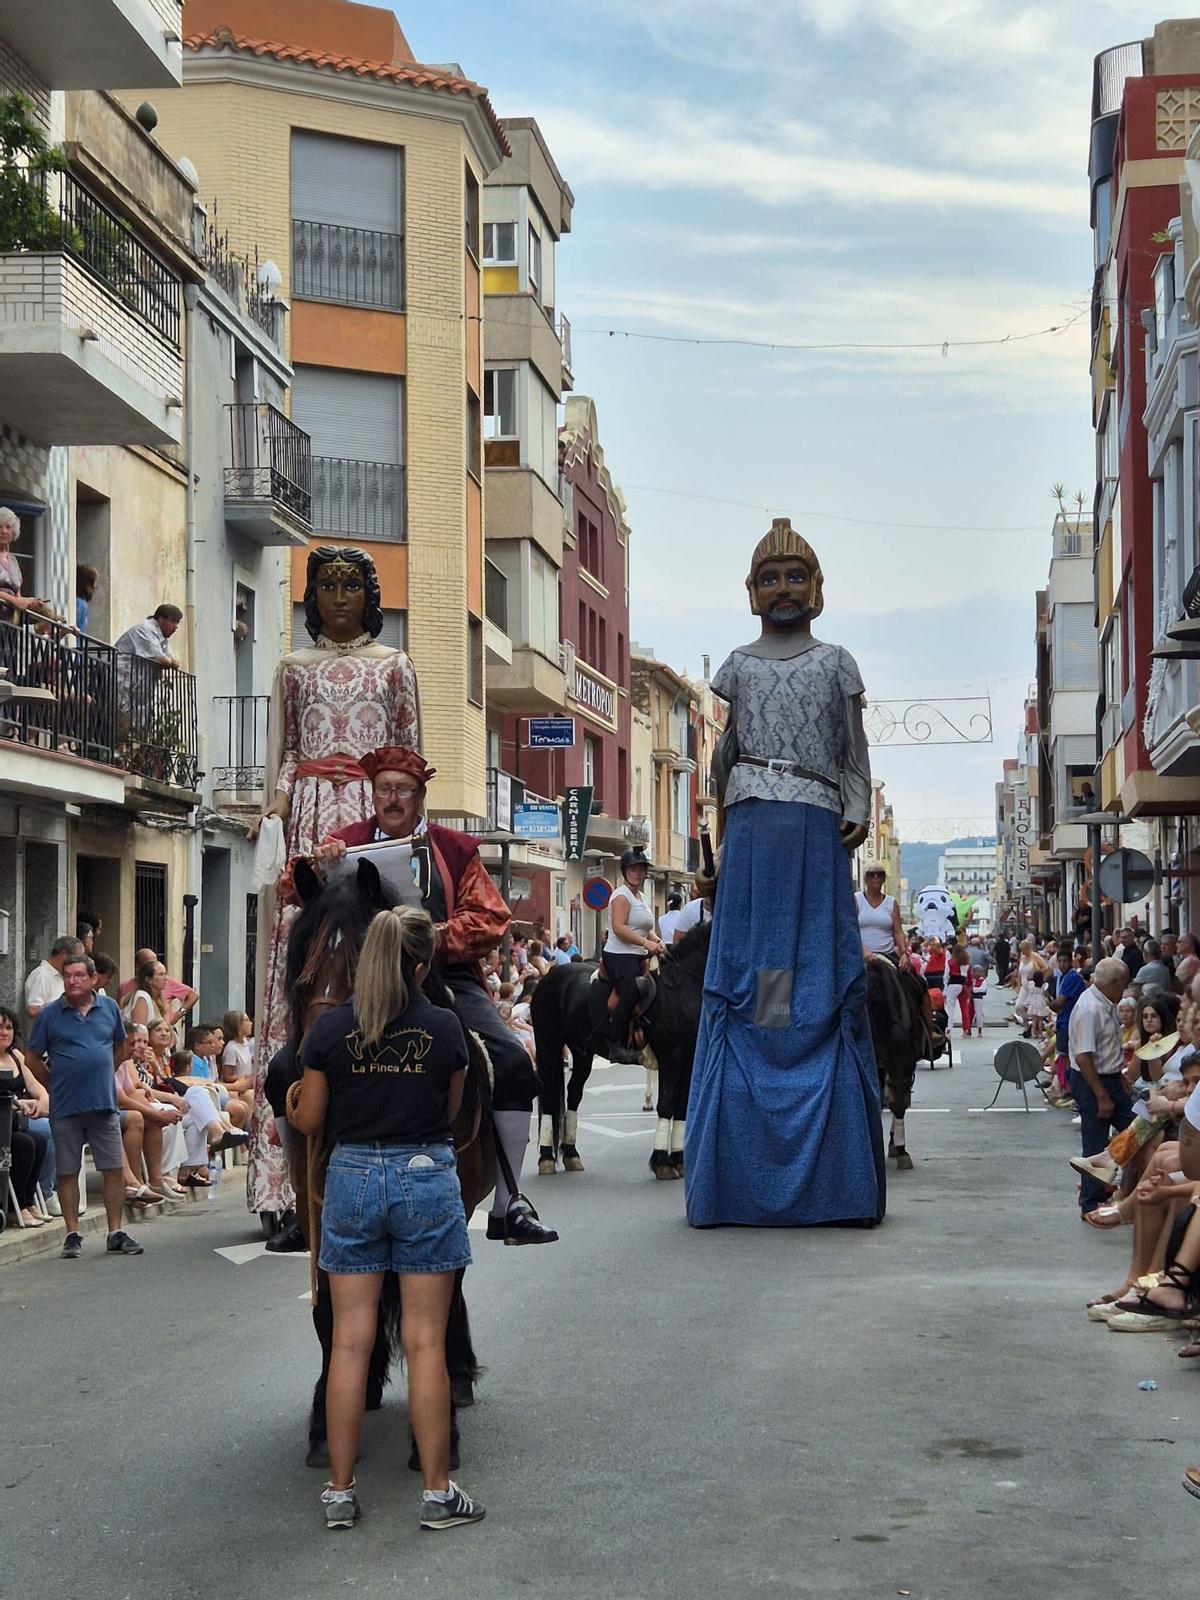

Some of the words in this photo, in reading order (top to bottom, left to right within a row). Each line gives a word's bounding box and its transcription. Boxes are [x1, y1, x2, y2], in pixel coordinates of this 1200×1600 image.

[576, 671, 614, 719] METROPOL
[568, 788, 580, 860] CARNISSERIA
[1016, 799, 1029, 871] FLORES
[352, 1063, 366, 1073] La
[369, 1063, 400, 1073] Finca
[403, 1063, 427, 1074] A.E.
